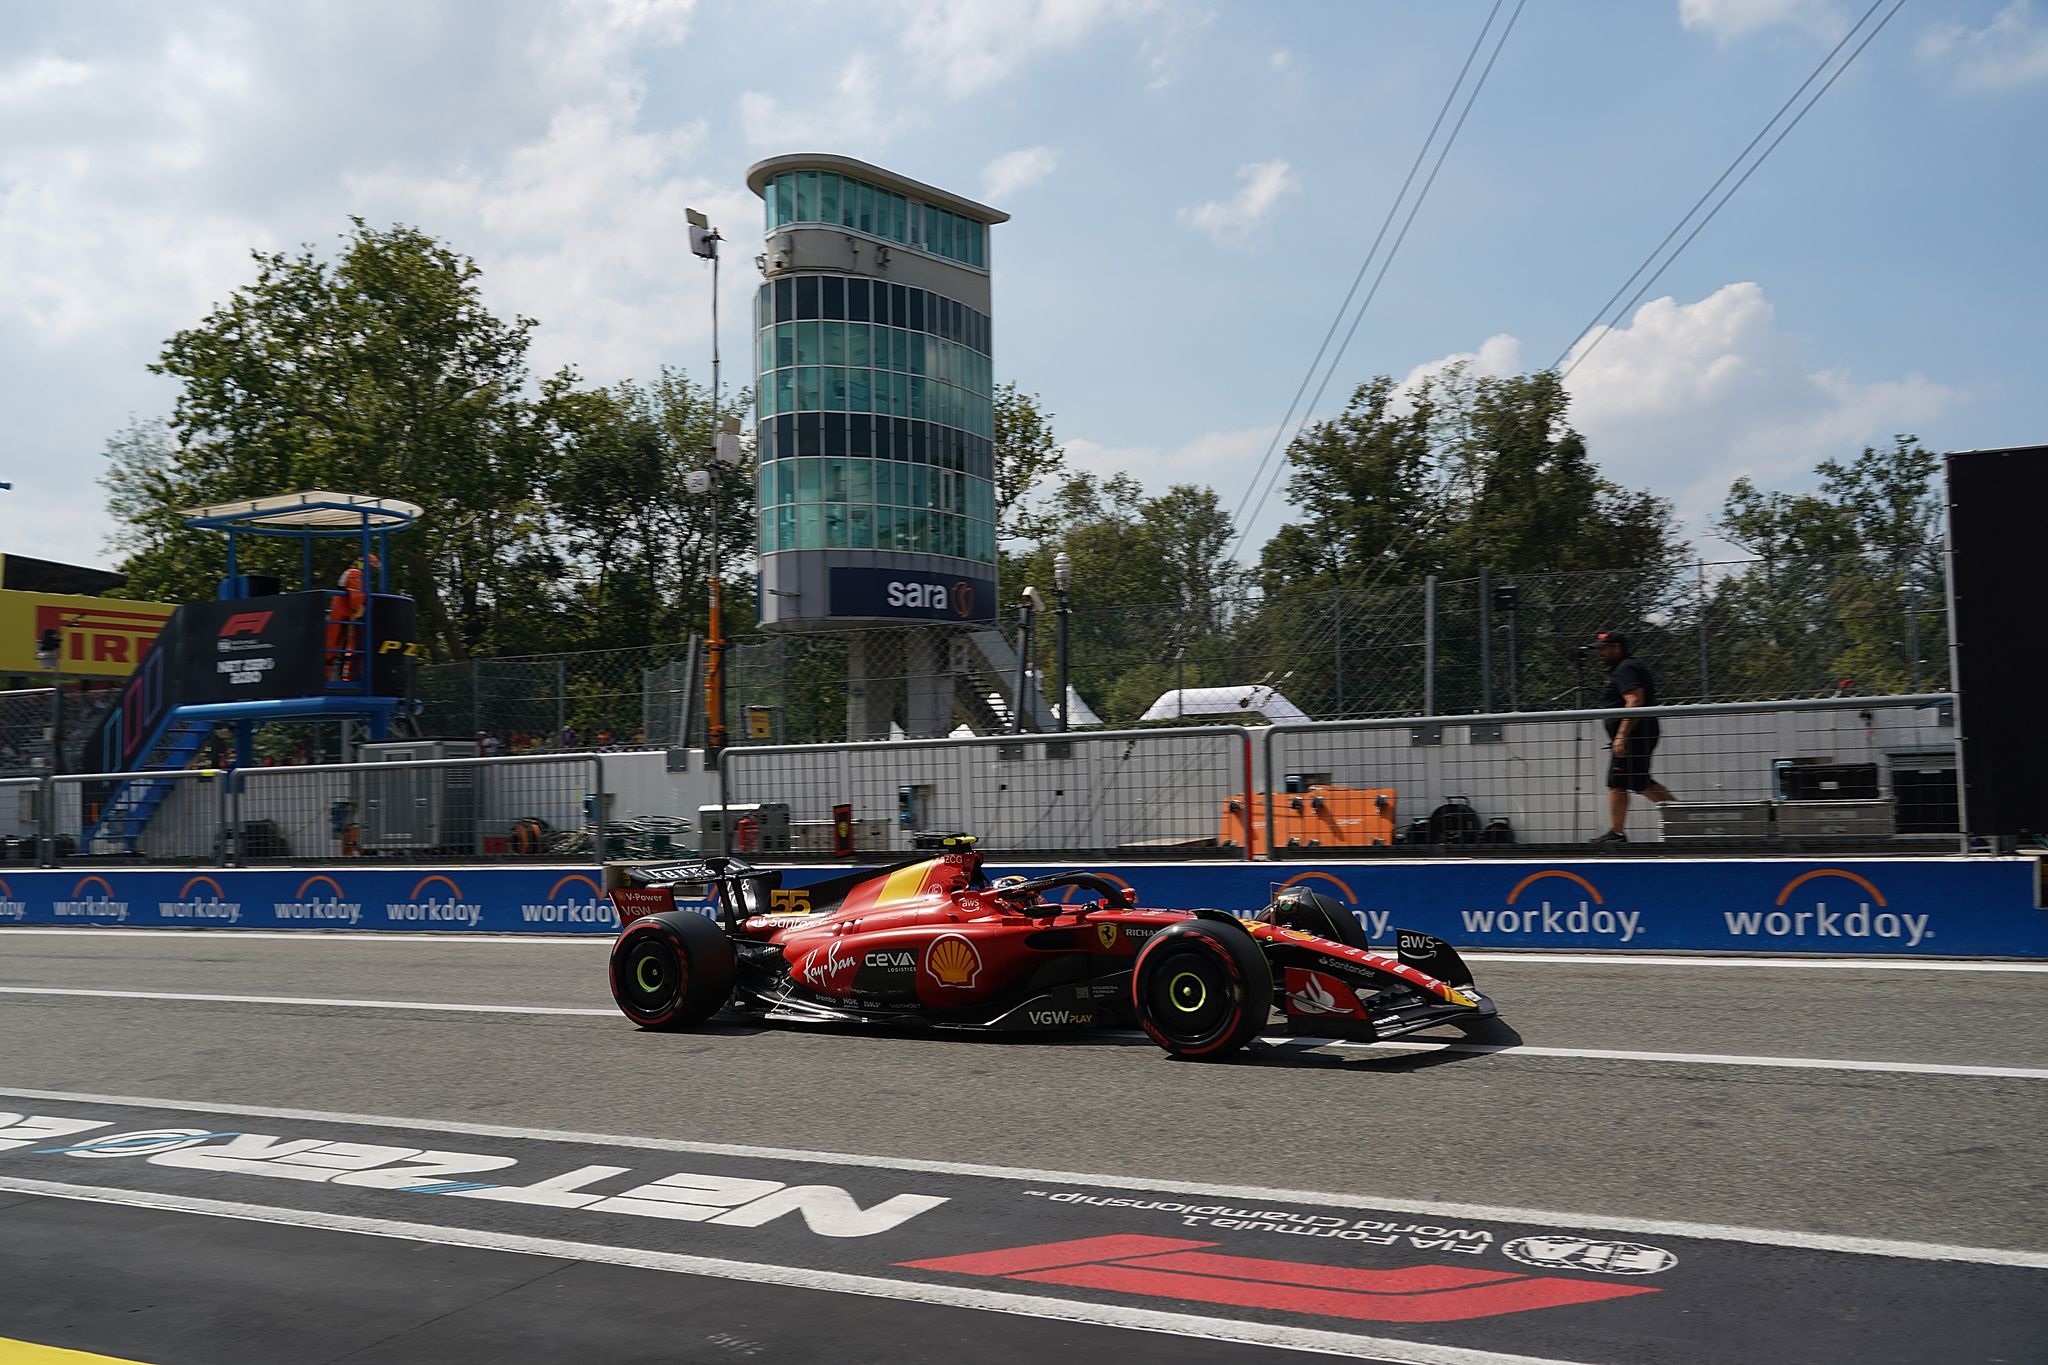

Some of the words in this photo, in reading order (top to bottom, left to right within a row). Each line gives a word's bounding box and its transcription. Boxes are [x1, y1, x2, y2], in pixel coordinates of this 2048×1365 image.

[887, 581, 948, 610] sara
[52, 896, 129, 921] workday
[625, 892, 663, 902] V-Power
[770, 889, 811, 915] 55
[962, 899, 980, 907] aws
[158, 897, 241, 923] workday
[273, 897, 362, 924] workday
[386, 898, 482, 926] workday
[521, 898, 621, 928] workday
[621, 905, 651, 917] VGW
[1460, 901, 1641, 942] workday
[1125, 928, 1160, 937] RICHA
[1723, 902, 1930, 946] workday
[1400, 935, 1436, 949] aws
[1326, 958, 1376, 978] Santander
[1028, 1010, 1070, 1025] VGW
[1181, 1214, 1208, 1228] 1
[1209, 1217, 1400, 1246] Formula
[1352, 1219, 1494, 1243] World
[1409, 1235, 1493, 1255] FIA
